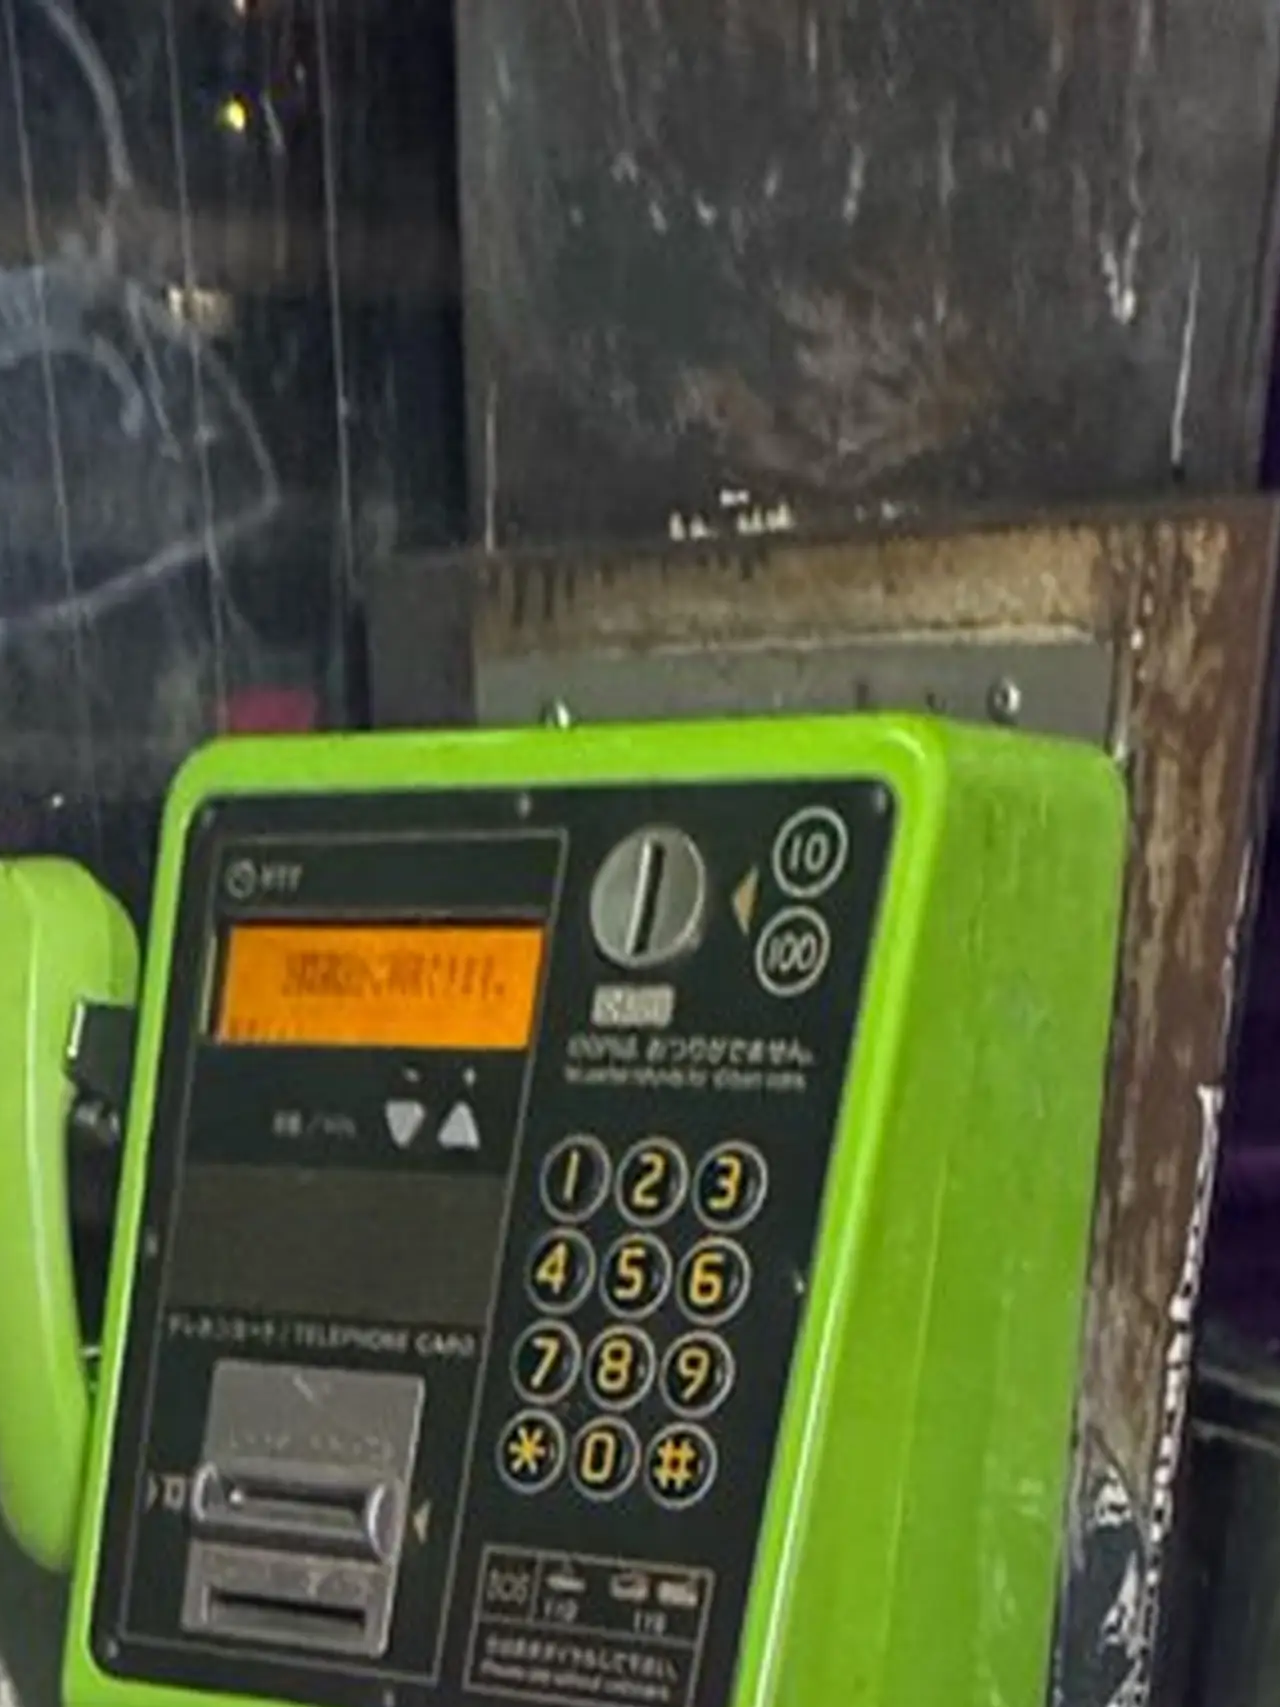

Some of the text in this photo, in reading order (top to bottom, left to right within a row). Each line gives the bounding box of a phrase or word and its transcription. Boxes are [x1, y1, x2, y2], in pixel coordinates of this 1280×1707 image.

[788, 831, 831, 877] 10
[767, 930, 819, 976] 100
[564, 1149, 743, 1210] 1 2 3
[536, 1243, 726, 1307] 4 5 6
[530, 1336, 713, 1401] 7 8 9
[581, 1431, 616, 1483] 0
[653, 1438, 698, 1491] #
